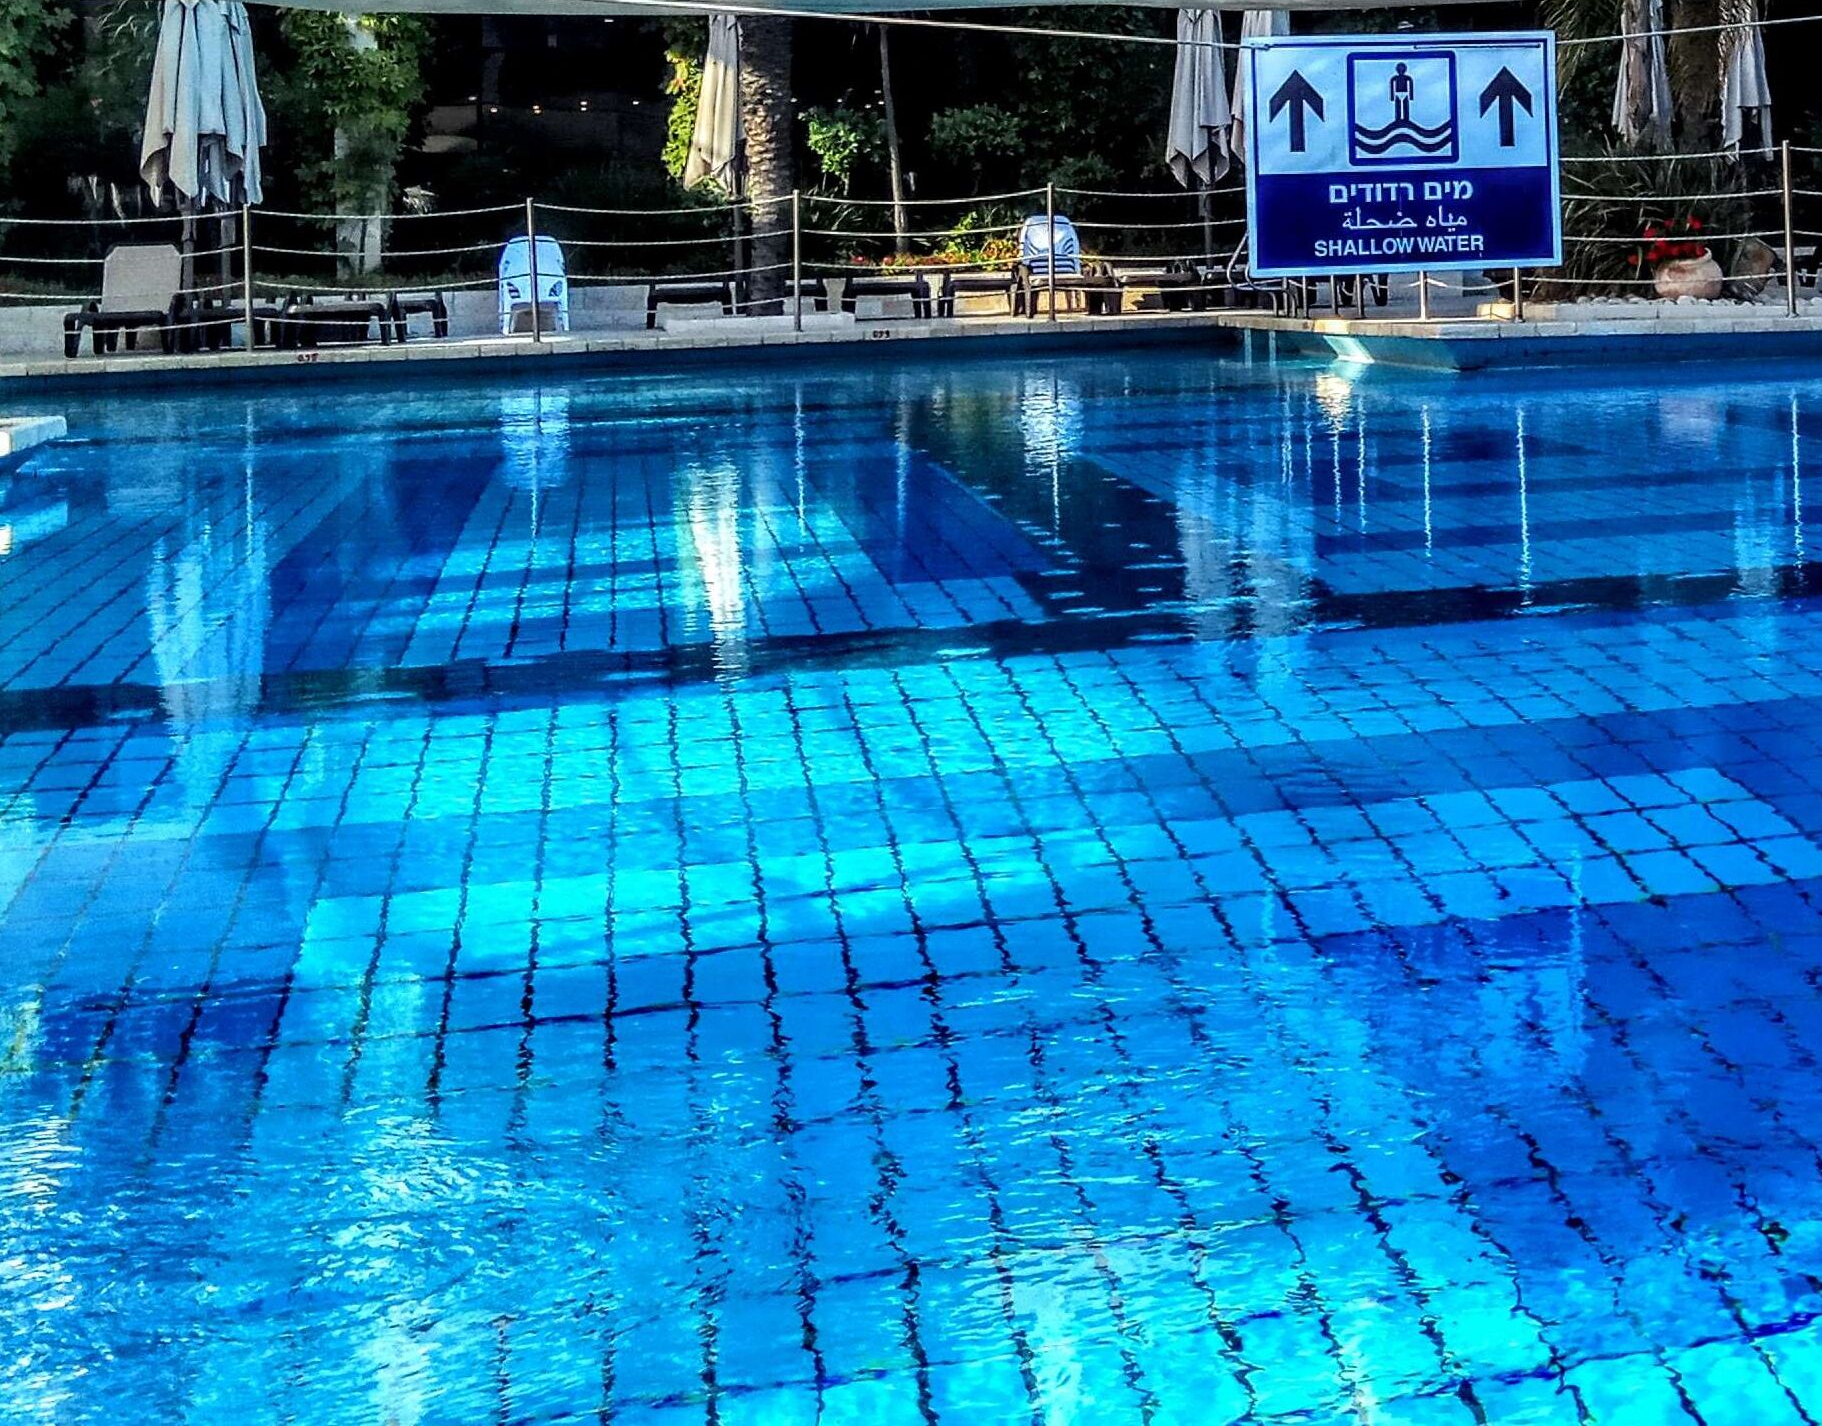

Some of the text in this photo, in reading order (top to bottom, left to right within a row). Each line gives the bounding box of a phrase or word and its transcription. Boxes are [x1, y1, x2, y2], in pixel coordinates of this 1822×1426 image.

[1329, 180, 1474, 204] מים רדודים
[1342, 205, 1468, 232] مياه ضحلة
[1314, 234, 1485, 257] SHALLOW WATER
